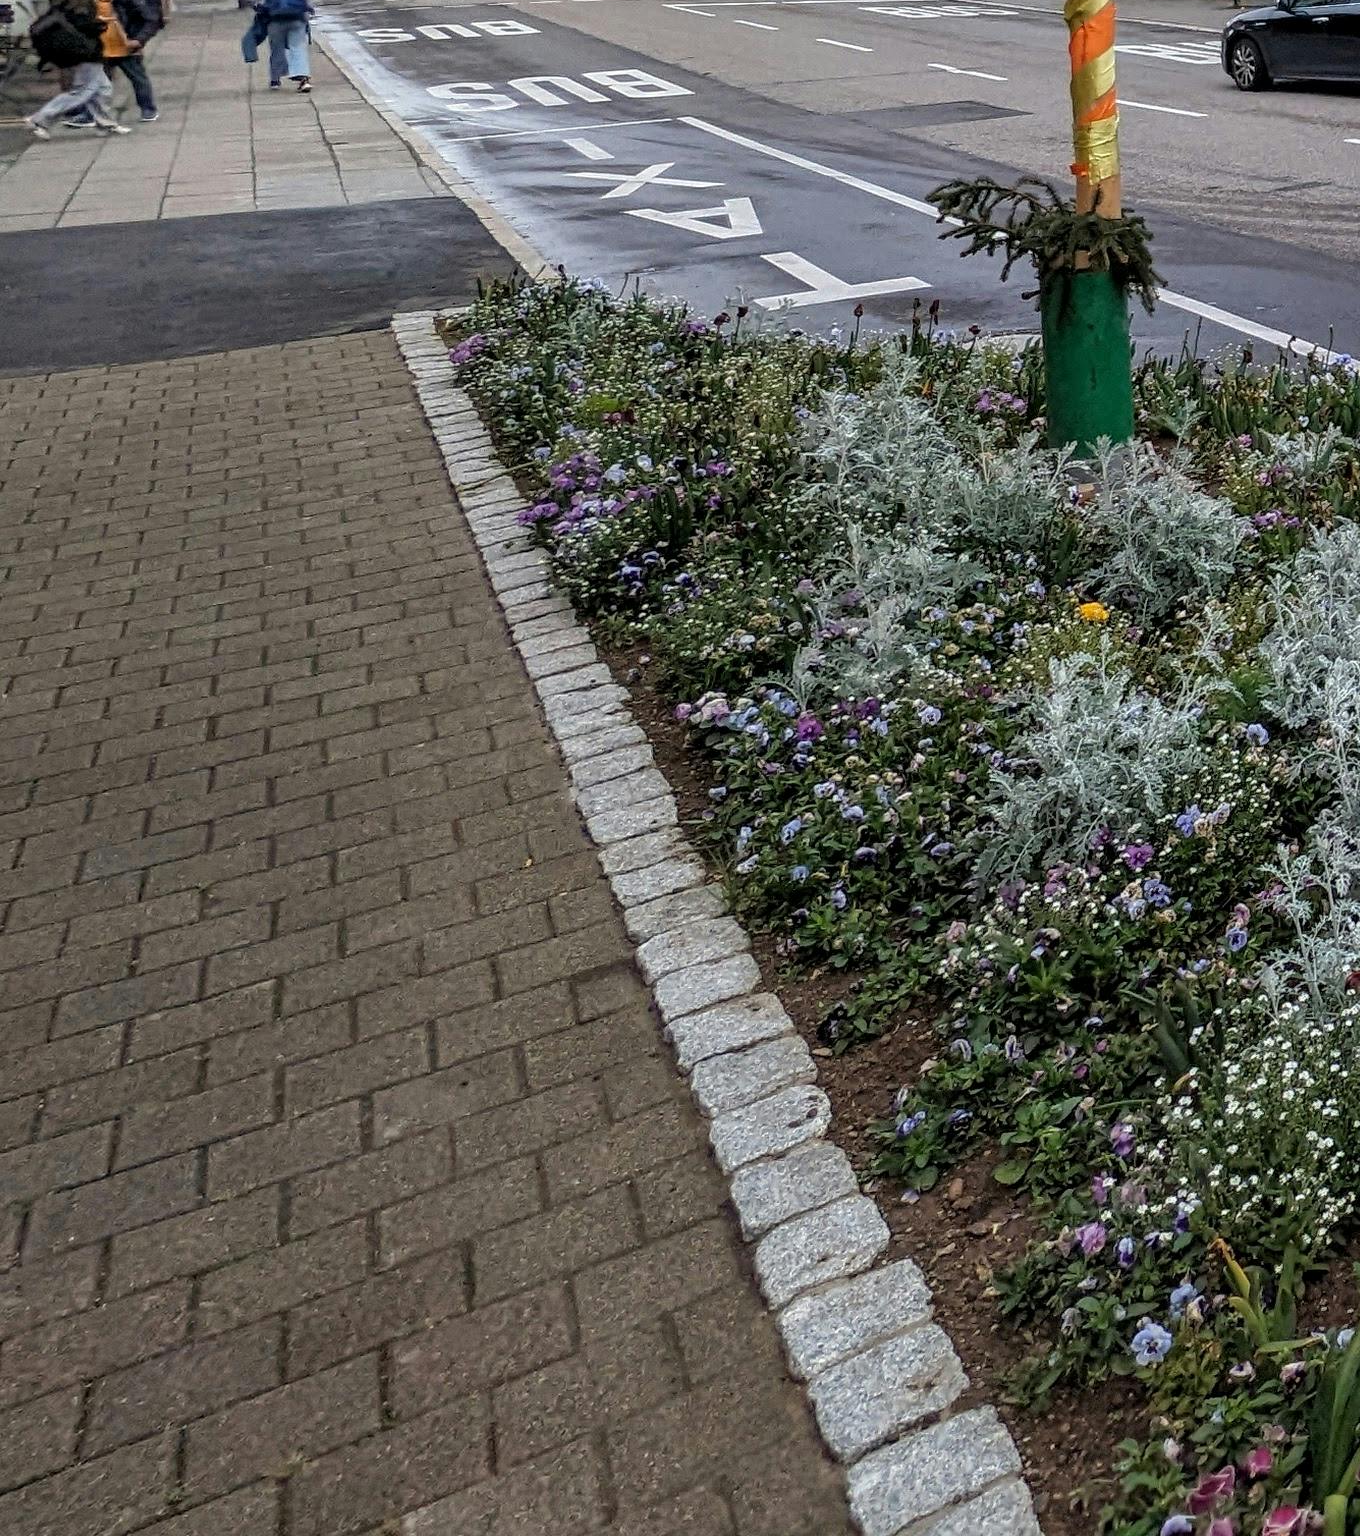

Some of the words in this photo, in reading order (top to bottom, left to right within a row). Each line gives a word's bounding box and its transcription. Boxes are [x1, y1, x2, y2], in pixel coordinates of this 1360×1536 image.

[857, 6, 1020, 18] BUS
[356, 20, 542, 43] BUS
[426, 69, 695, 112] BUS
